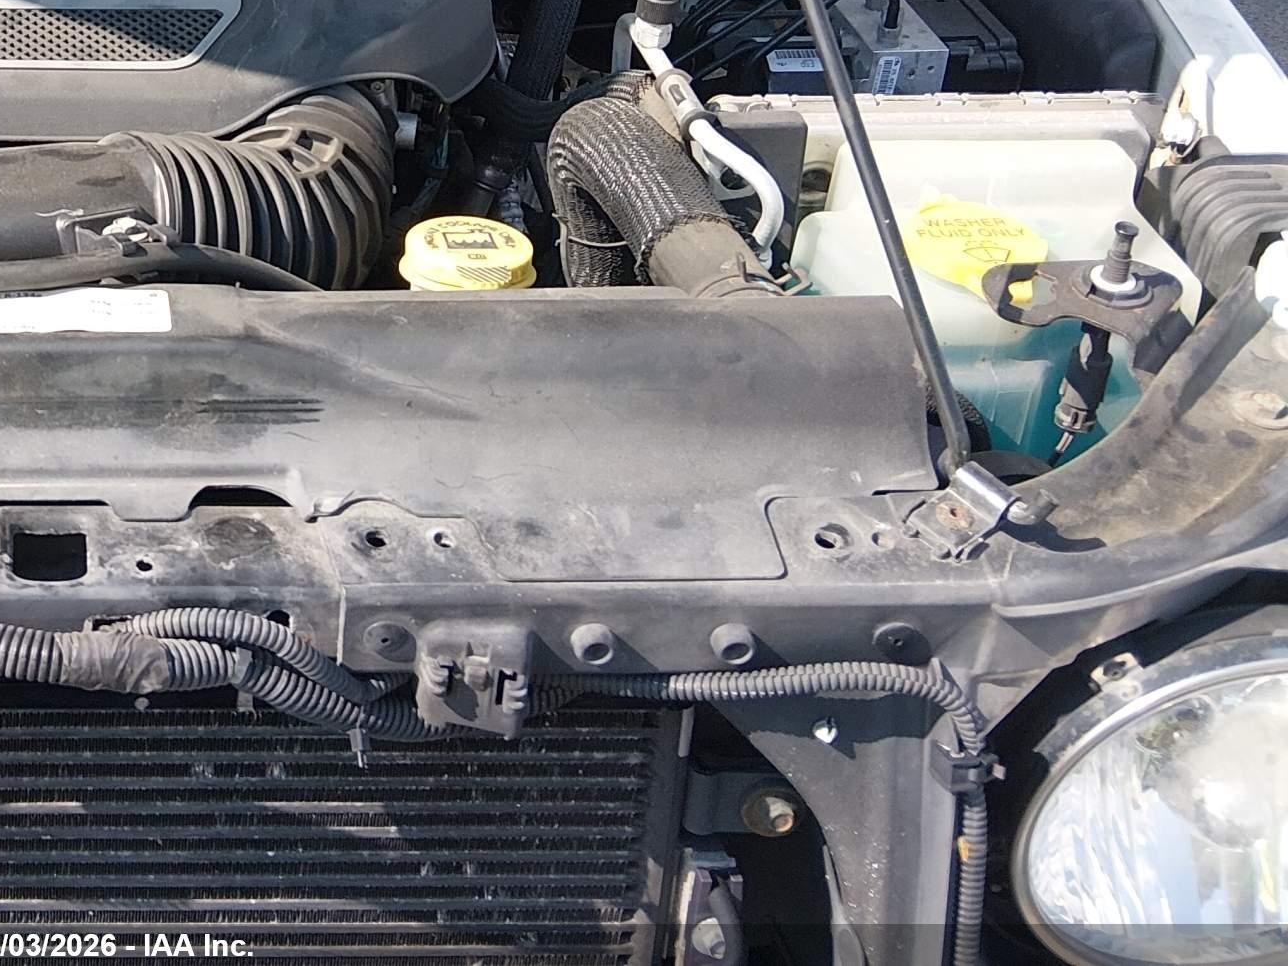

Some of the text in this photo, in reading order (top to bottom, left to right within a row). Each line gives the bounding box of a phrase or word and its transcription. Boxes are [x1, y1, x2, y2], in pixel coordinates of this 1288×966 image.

[925, 217, 1006, 227] WASHER
[916, 227, 1026, 239] FLUID ONLY
